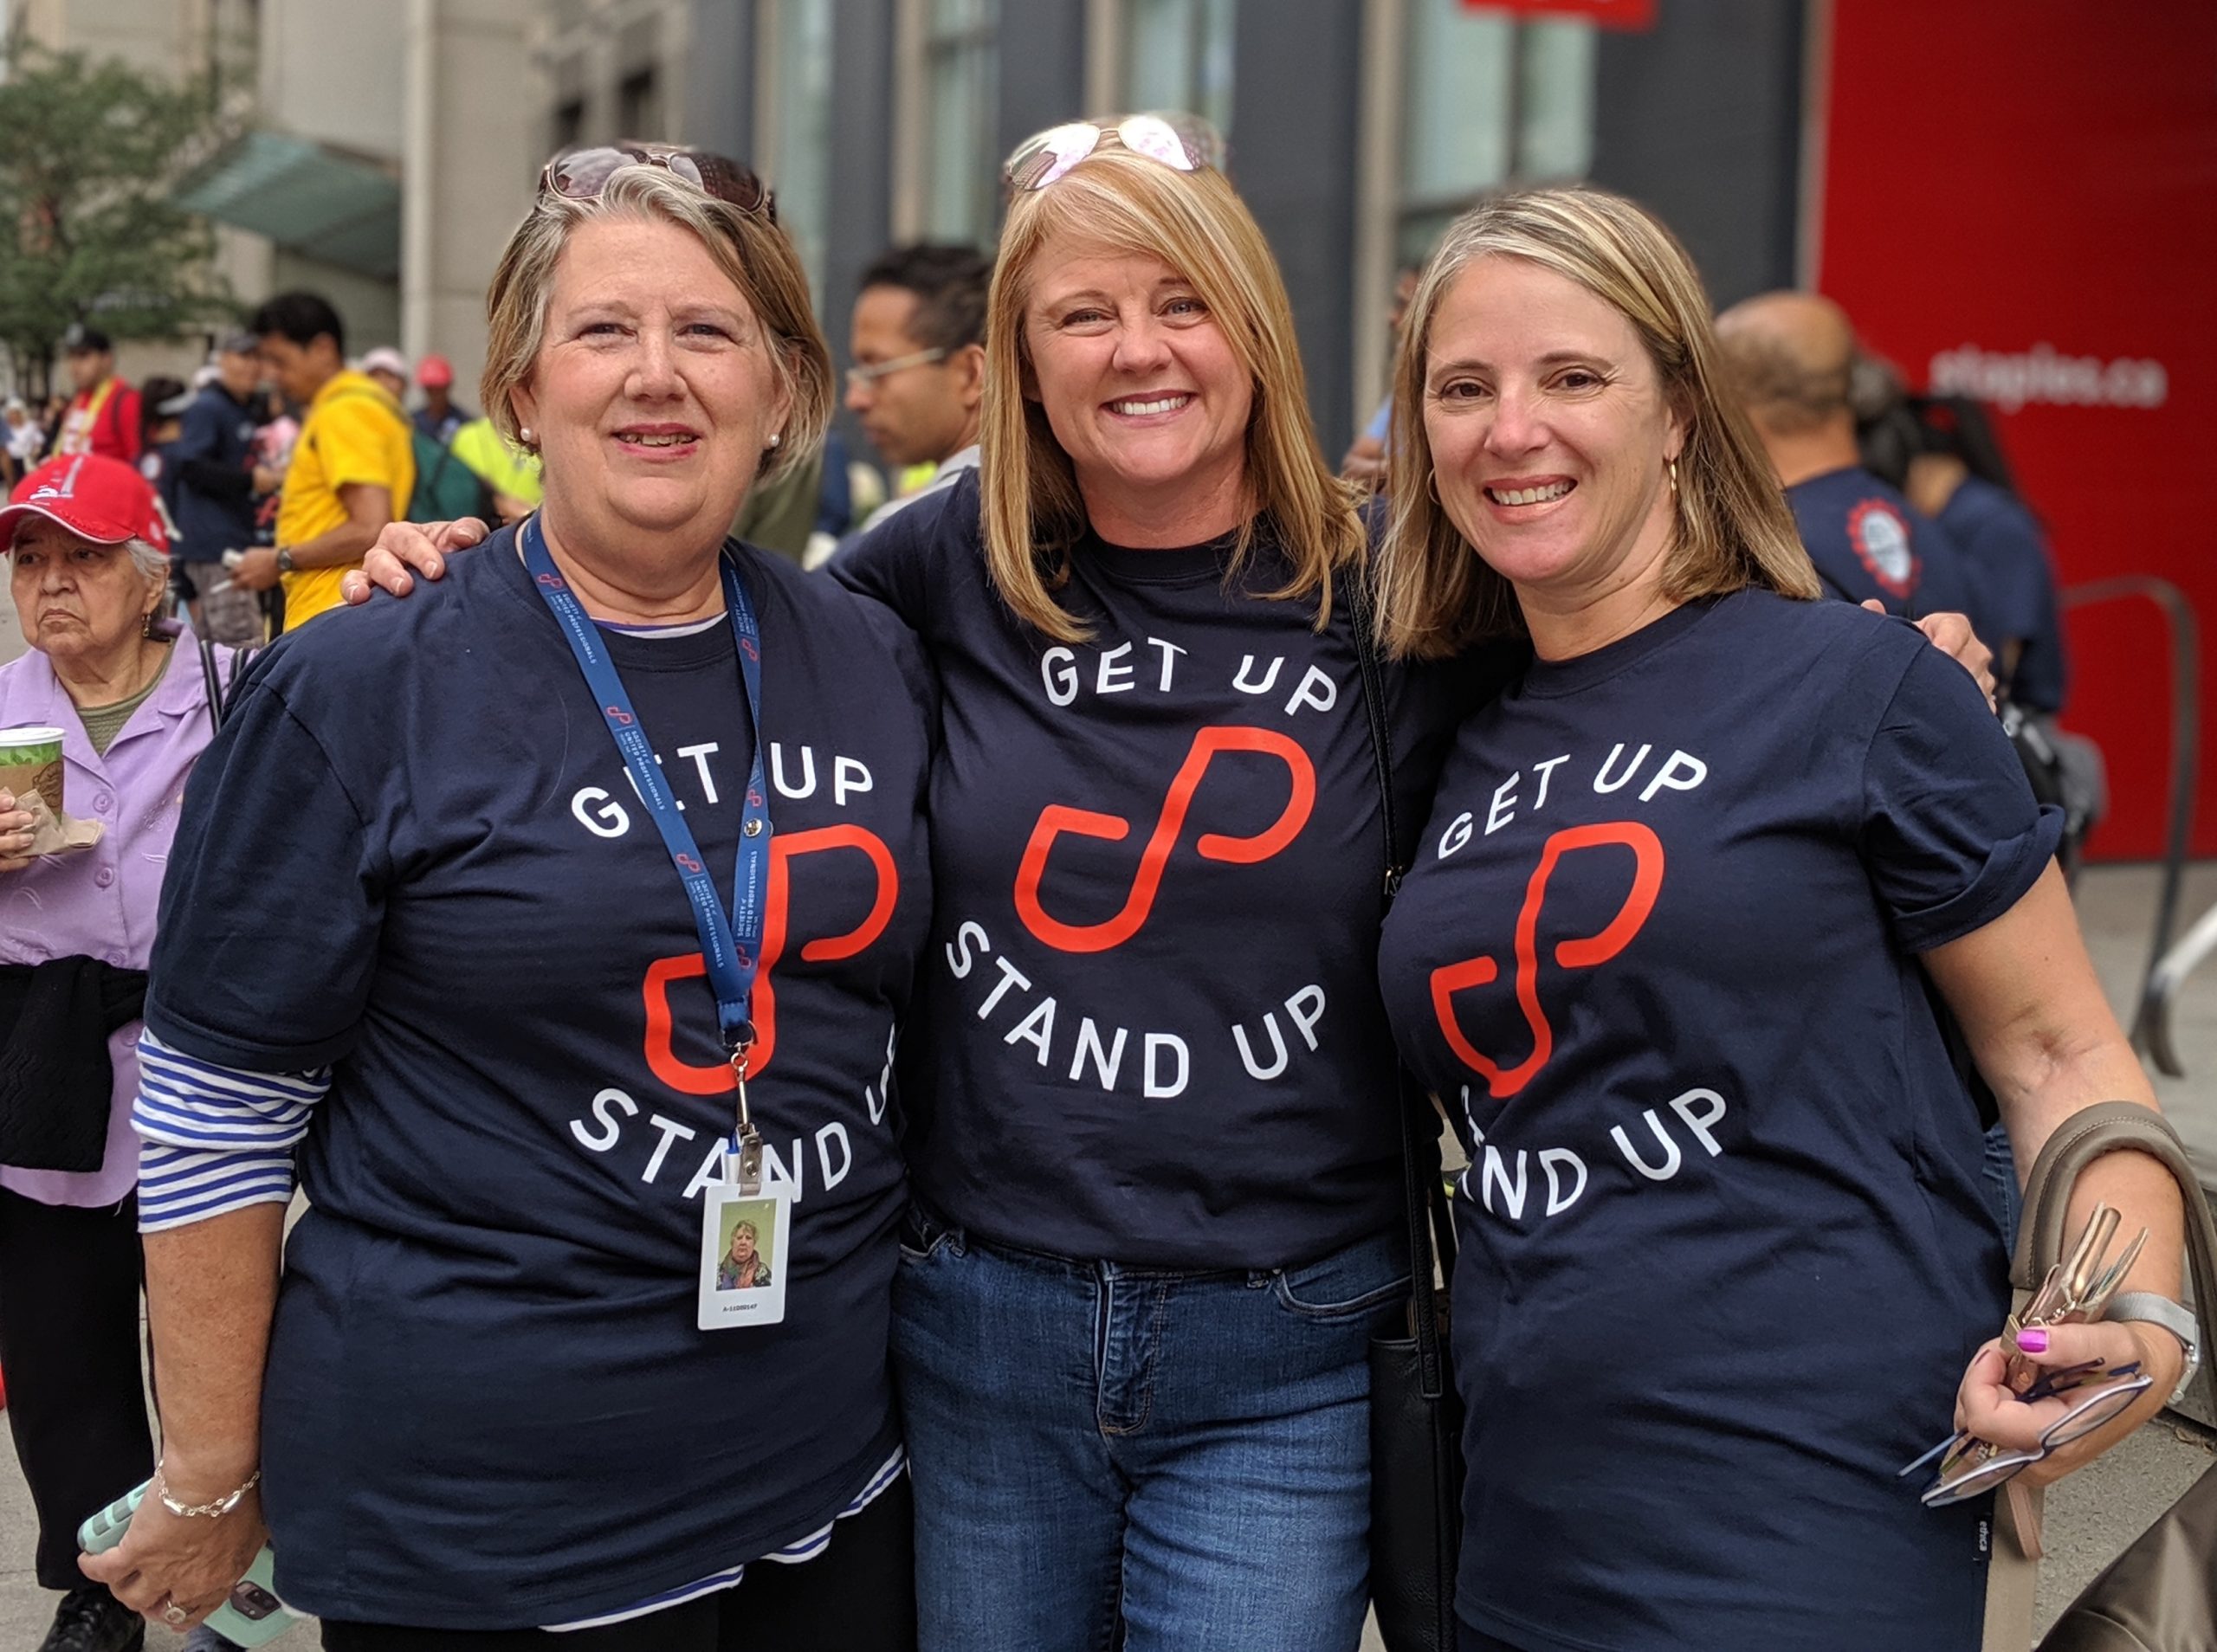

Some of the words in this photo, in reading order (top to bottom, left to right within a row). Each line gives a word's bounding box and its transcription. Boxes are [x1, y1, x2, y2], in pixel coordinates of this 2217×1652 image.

[1041, 637, 1187, 706] GET
[1232, 655, 1337, 716] UP
[770, 742, 874, 806] UP
[1438, 754, 1570, 859] GET
[1593, 743, 1708, 802] UP
[946, 921, 1189, 1098] STAND
[1231, 984, 1326, 1080] UP
[1610, 1087, 1727, 1181] UP
